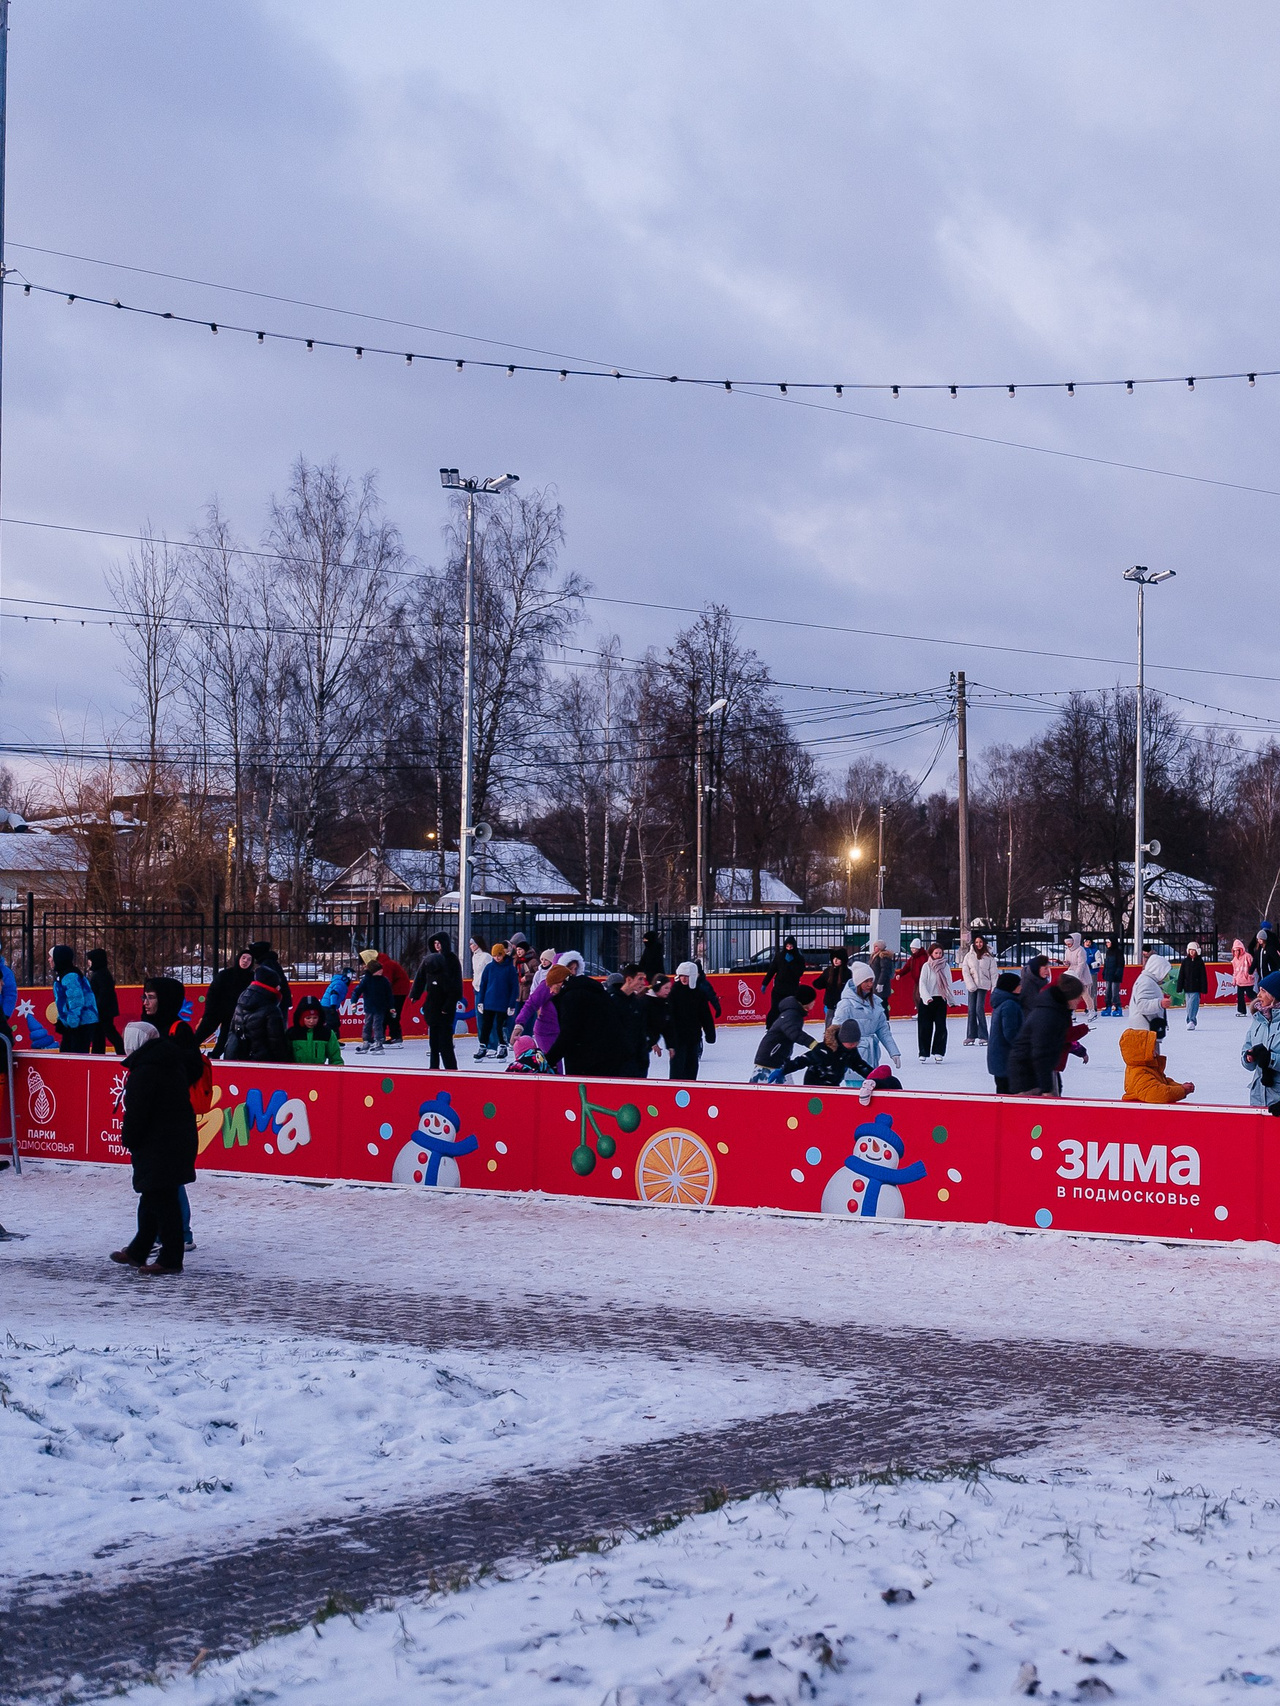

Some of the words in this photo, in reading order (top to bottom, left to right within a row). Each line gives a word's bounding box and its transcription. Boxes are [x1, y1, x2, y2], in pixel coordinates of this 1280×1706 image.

[27, 1129, 56, 1140] ПАРКИ
[9, 1139, 75, 1153] ОДМОСКОВЬЯ
[1057, 1186, 1066, 1198] в
[1073, 1186, 1200, 1206] подмосковье
